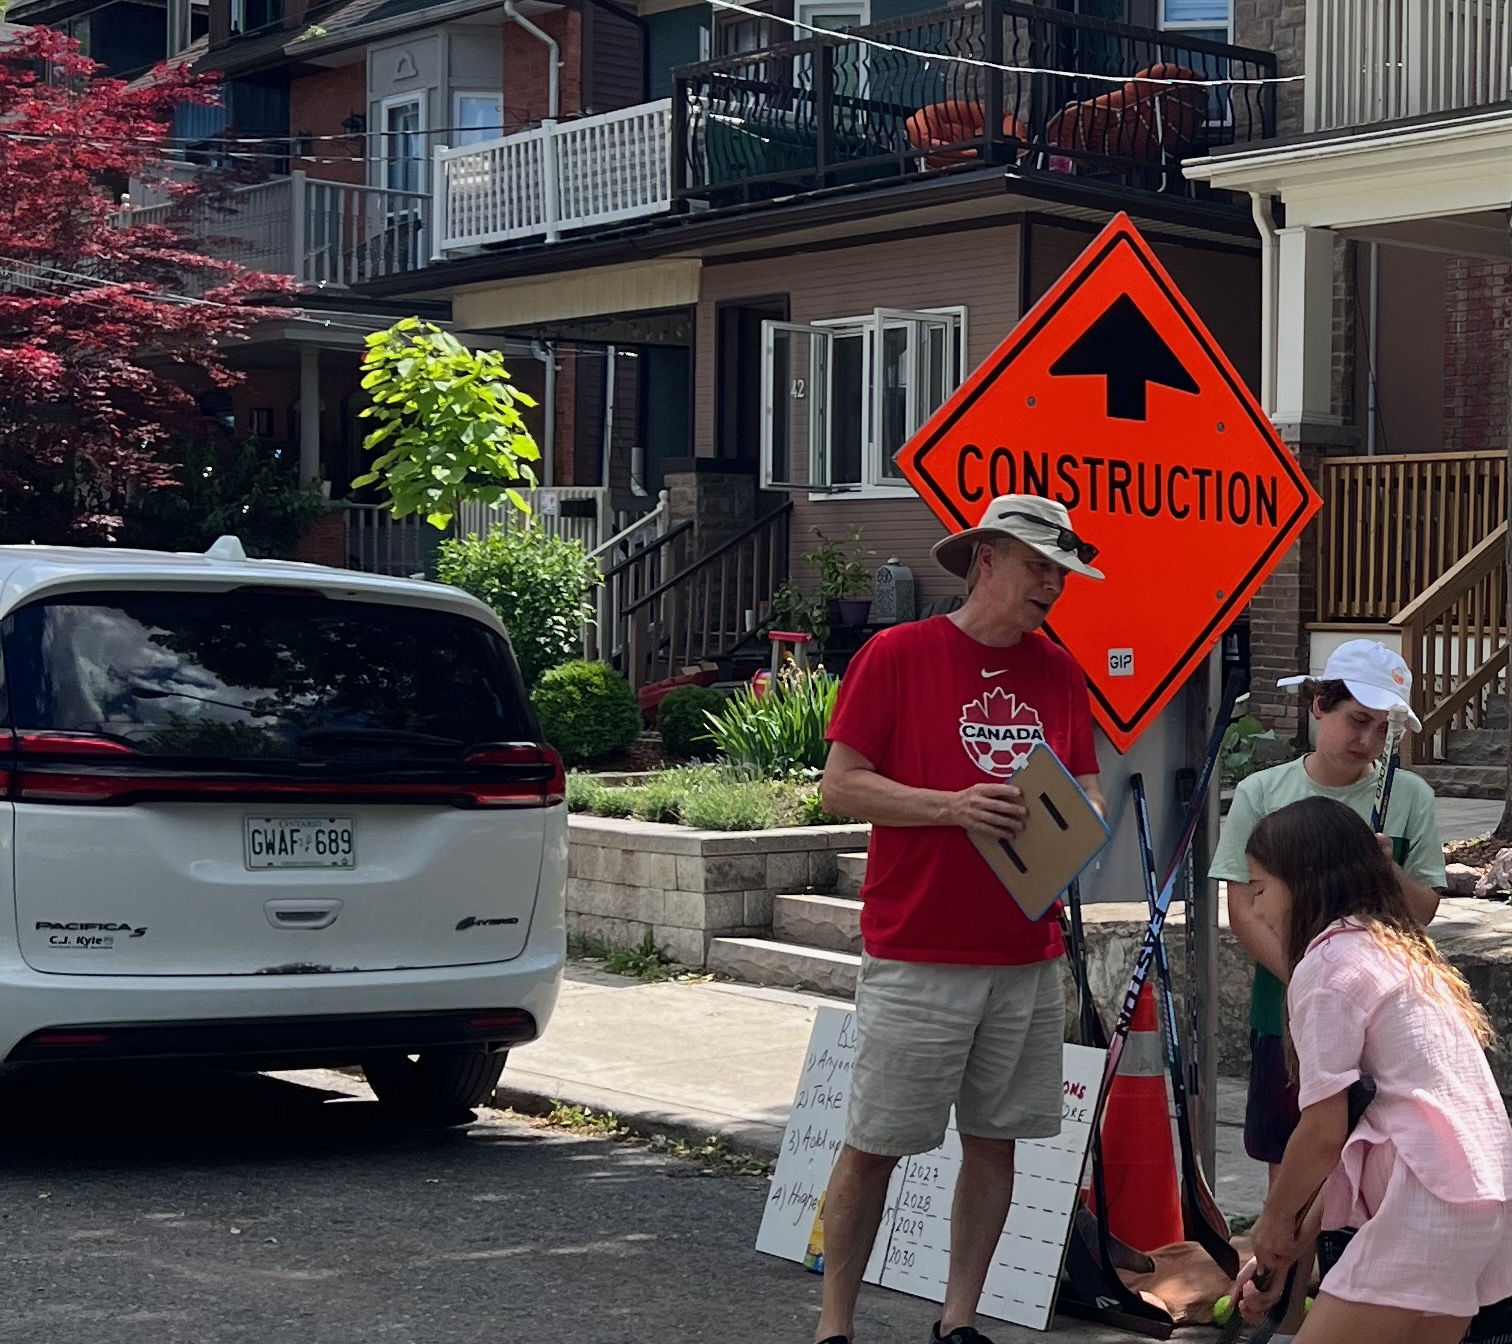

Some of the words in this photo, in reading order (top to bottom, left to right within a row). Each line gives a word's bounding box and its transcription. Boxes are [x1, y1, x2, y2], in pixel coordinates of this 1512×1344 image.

[791, 379, 805, 399] 42
[956, 443, 1279, 528] CONSTRUCTION
[1109, 654, 1132, 669] GIP
[962, 725, 1043, 741] CANADA
[251, 828, 300, 856] GWAF
[315, 828, 352, 855] 689
[35, 921, 132, 931] PACIFICA
[128, 927, 148, 938] S
[76, 935, 103, 948] Kyle
[811, 1084, 843, 1110] Take
[909, 1161, 939, 1183] 2027
[903, 1190, 932, 1213] 2028
[895, 1216, 924, 1238] 2029
[888, 1245, 915, 1268] 2030
